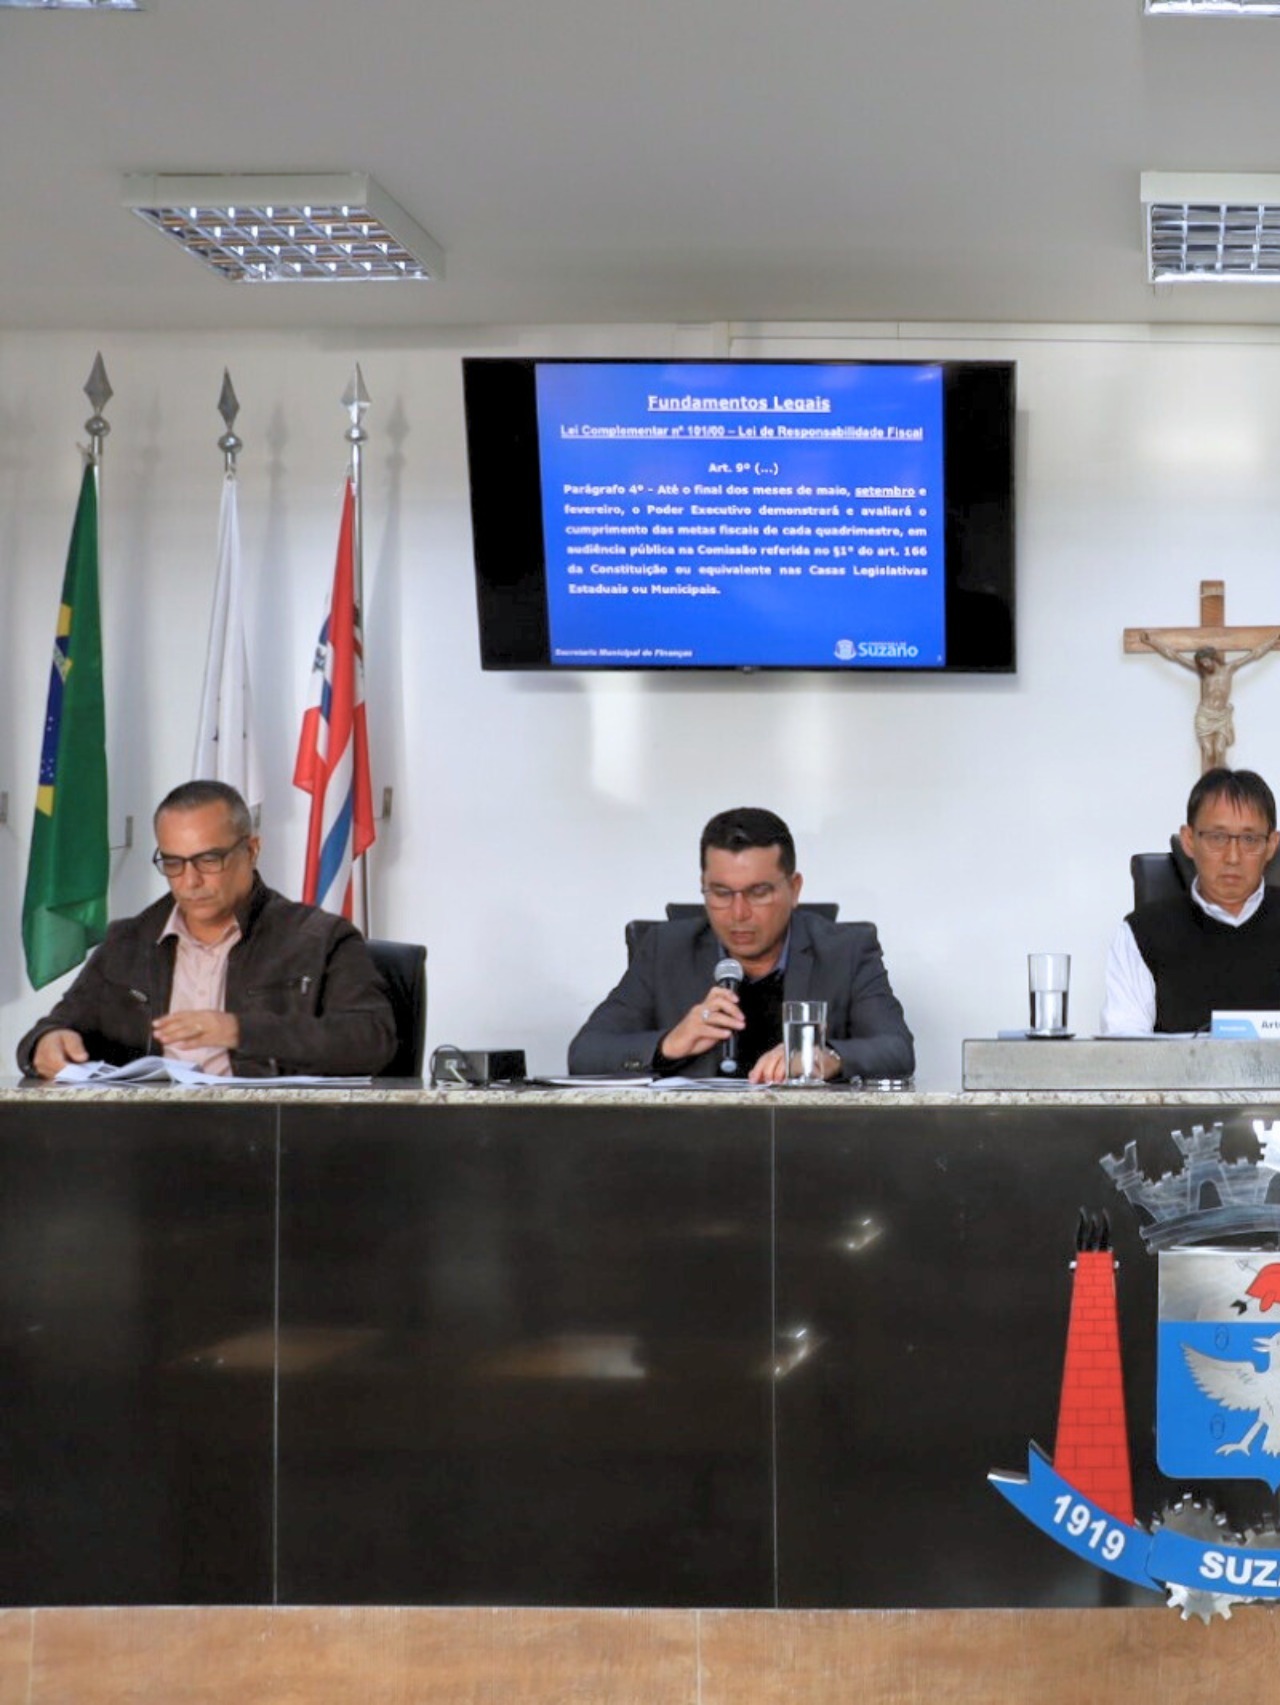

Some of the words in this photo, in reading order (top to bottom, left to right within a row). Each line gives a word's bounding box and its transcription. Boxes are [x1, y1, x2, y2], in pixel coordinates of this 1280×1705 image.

[648, 395, 767, 413] Fundamentos
[774, 396, 831, 413] Legais
[561, 425, 579, 438] Lei
[582, 425, 668, 439] Complementar
[688, 425, 725, 439] 101/00
[738, 426, 756, 439] Lei
[760, 427, 774, 440] de
[778, 426, 883, 440] Responsabilidade
[887, 427, 923, 441] Fiscal
[709, 463, 732, 473] Art.
[754, 462, 779, 475] (...)
[563, 484, 625, 496] Parágrafo
[657, 484, 678, 495] Até
[682, 487, 691, 495] o
[694, 484, 722, 495] final
[726, 485, 748, 495] dos
[753, 487, 792, 496] meses
[796, 485, 812, 496] de
[816, 485, 851, 497] maio,
[855, 486, 916, 498] setembro
[918, 487, 927, 496] e
[564, 504, 624, 516] fevereiro,
[632, 506, 640, 515] o
[647, 505, 684, 515] Poder
[690, 505, 751, 515] Executivo
[759, 505, 839, 516] demonstrará
[846, 507, 853, 516] e
[861, 505, 912, 516] avaliará
[918, 508, 927, 516] o
[565, 525, 648, 536] cumprimento
[652, 525, 674, 535] das
[678, 525, 716, 535] metas
[719, 524, 759, 535] fiscais
[763, 525, 778, 536] de
[782, 525, 812, 536] cada
[816, 525, 903, 537] quadrimestre,
[908, 528, 927, 536] em
[567, 544, 626, 554] audiência
[629, 543, 675, 557] pública
[678, 546, 694, 555] na
[697, 544, 757, 555] Comissão
[761, 545, 810, 555] referida
[814, 547, 830, 555] no
[858, 546, 873, 556] do
[877, 547, 899, 556] art.
[904, 546, 927, 556] 166
[567, 564, 583, 574] da
[590, 564, 667, 576] Constituição
[675, 566, 691, 574] ou
[698, 564, 771, 576] equivalente
[780, 567, 801, 575] nas
[809, 565, 845, 575] Casas
[853, 565, 927, 577] Legislativas
[568, 584, 628, 594] Estaduais
[632, 586, 647, 594] ou
[651, 584, 721, 596] Municipais.
[858, 642, 919, 657] Suzano
[1053, 1494, 1125, 1561] 1919
